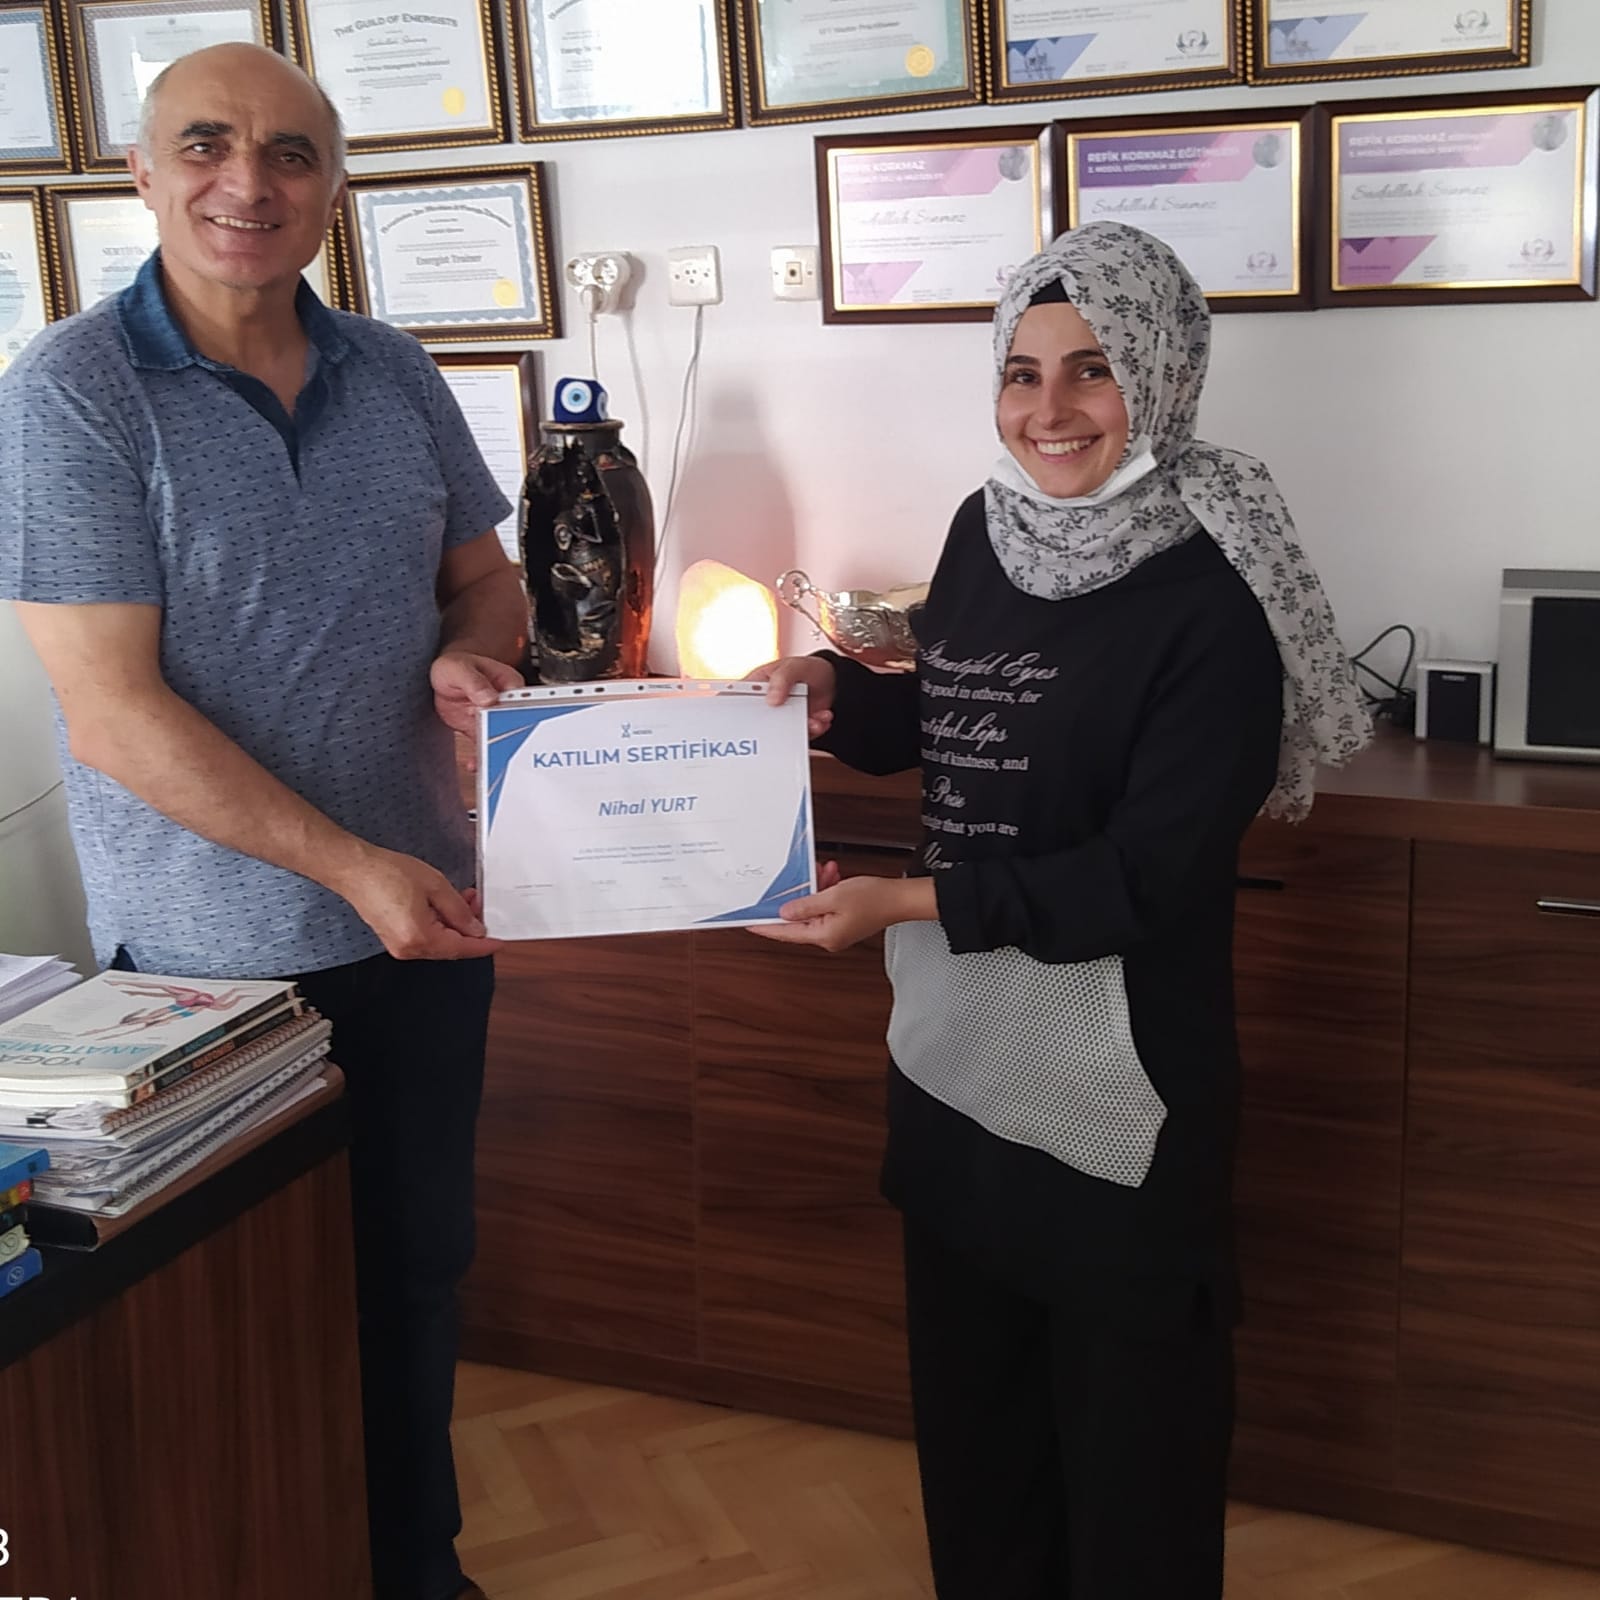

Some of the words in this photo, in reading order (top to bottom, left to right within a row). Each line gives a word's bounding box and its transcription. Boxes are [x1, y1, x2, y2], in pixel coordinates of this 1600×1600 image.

[333, 25, 355, 37] THE
[355, 17, 386, 30] GUILD
[386, 15, 400, 24] OF
[401, 13, 458, 27] ENERGISTS
[1087, 150, 1120, 163] REFİK
[1120, 149, 1177, 161] KORKMAZ
[1001, 652, 1059, 687] Eyes
[931, 684, 957, 698] good
[957, 685, 971, 699] in
[971, 687, 1016, 704] others,
[1018, 690, 1042, 703] for
[960, 711, 1009, 751] Lips
[533, 748, 620, 769] KATILIM
[627, 739, 758, 762] SERTİFİKASI
[1002, 757, 1029, 770] and
[598, 799, 646, 816] Nihal
[651, 796, 697, 813] YURT
[967, 823, 996, 837] you
[998, 823, 1019, 836] are
[0, 1054, 85, 1066] YOGA
